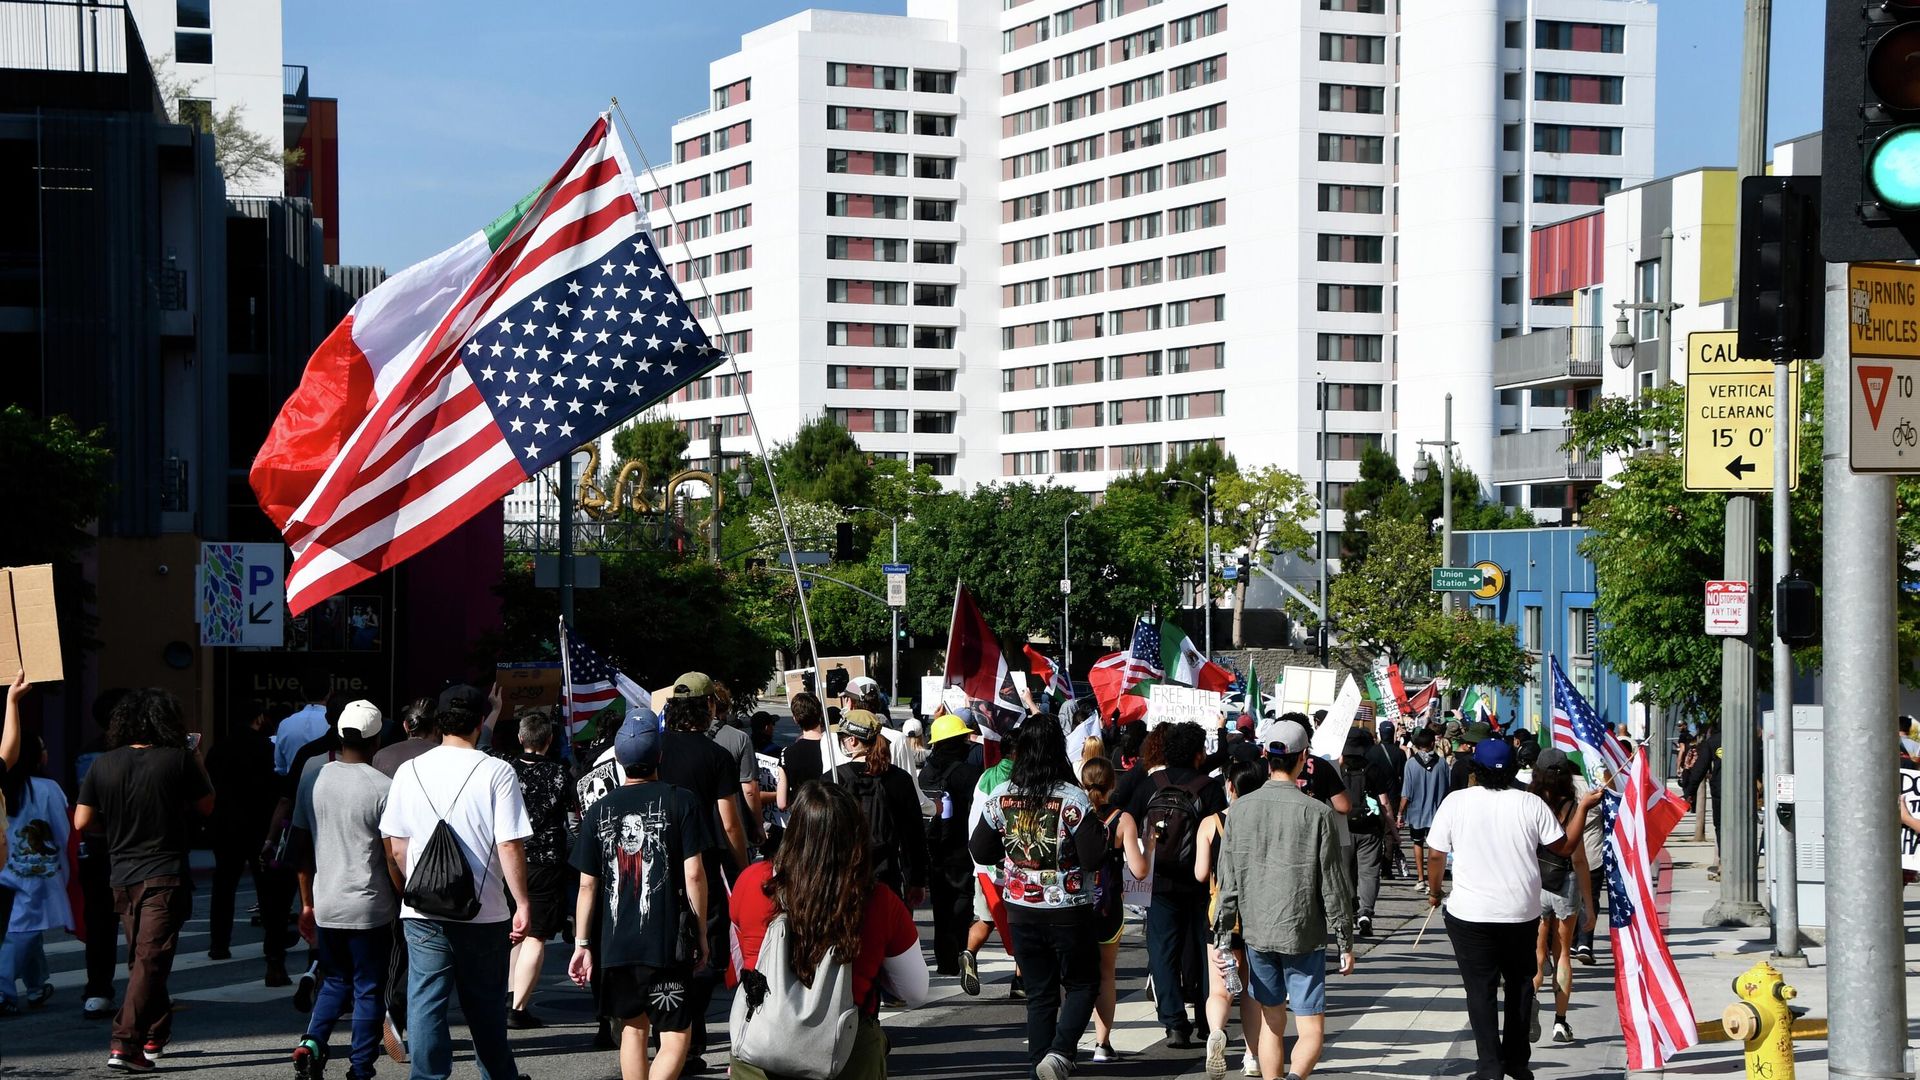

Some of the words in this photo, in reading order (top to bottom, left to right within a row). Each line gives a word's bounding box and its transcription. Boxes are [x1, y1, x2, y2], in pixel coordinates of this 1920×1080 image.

[1857, 280, 1915, 306] TURNING
[1857, 319, 1918, 343] VEHICLES
[1709, 384, 1774, 398] VERTICAL
[1897, 375, 1913, 398] TO
[1701, 405, 1774, 419] CLEARANC
[1712, 428, 1738, 448] 15'
[249, 565, 274, 595] P
[1440, 570, 1463, 578] Union
[1436, 579, 1467, 587] Station
[1707, 593, 1719, 605] NO
[1720, 594, 1745, 605] STOPPING
[1711, 607, 1724, 616] ANY
[1727, 607, 1742, 617] TIME
[330, 673, 369, 690] ine.
[1153, 686, 1183, 704] FREE
[1190, 688, 1216, 707] THE
[1166, 705, 1204, 716] HOMIES
